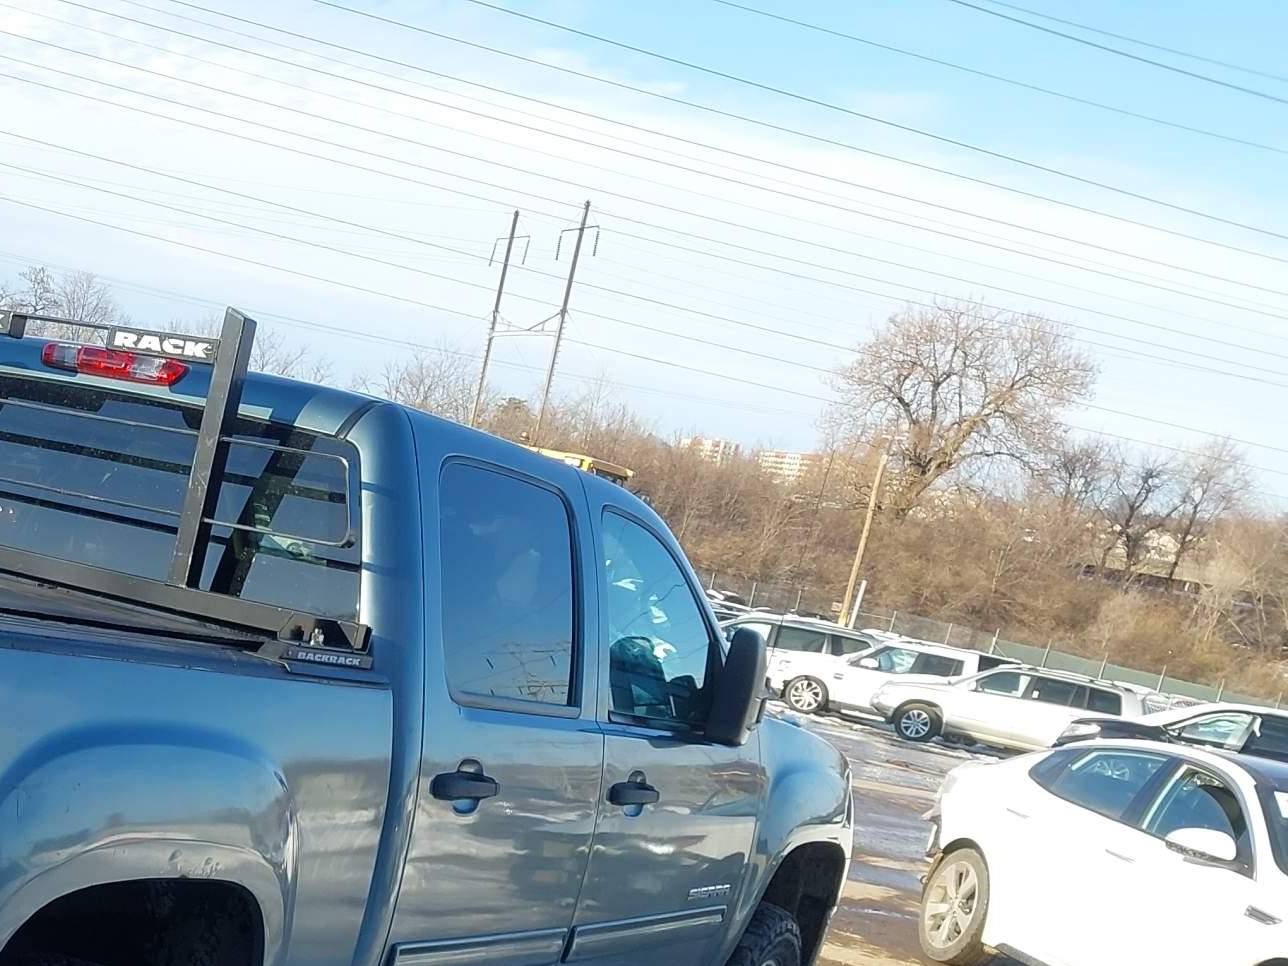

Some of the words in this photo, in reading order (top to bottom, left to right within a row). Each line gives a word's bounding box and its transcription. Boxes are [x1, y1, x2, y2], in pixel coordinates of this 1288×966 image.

[113, 331, 213, 359] RACK
[297, 651, 361, 666] BACKRACK
[687, 884, 731, 901] SIERRA
